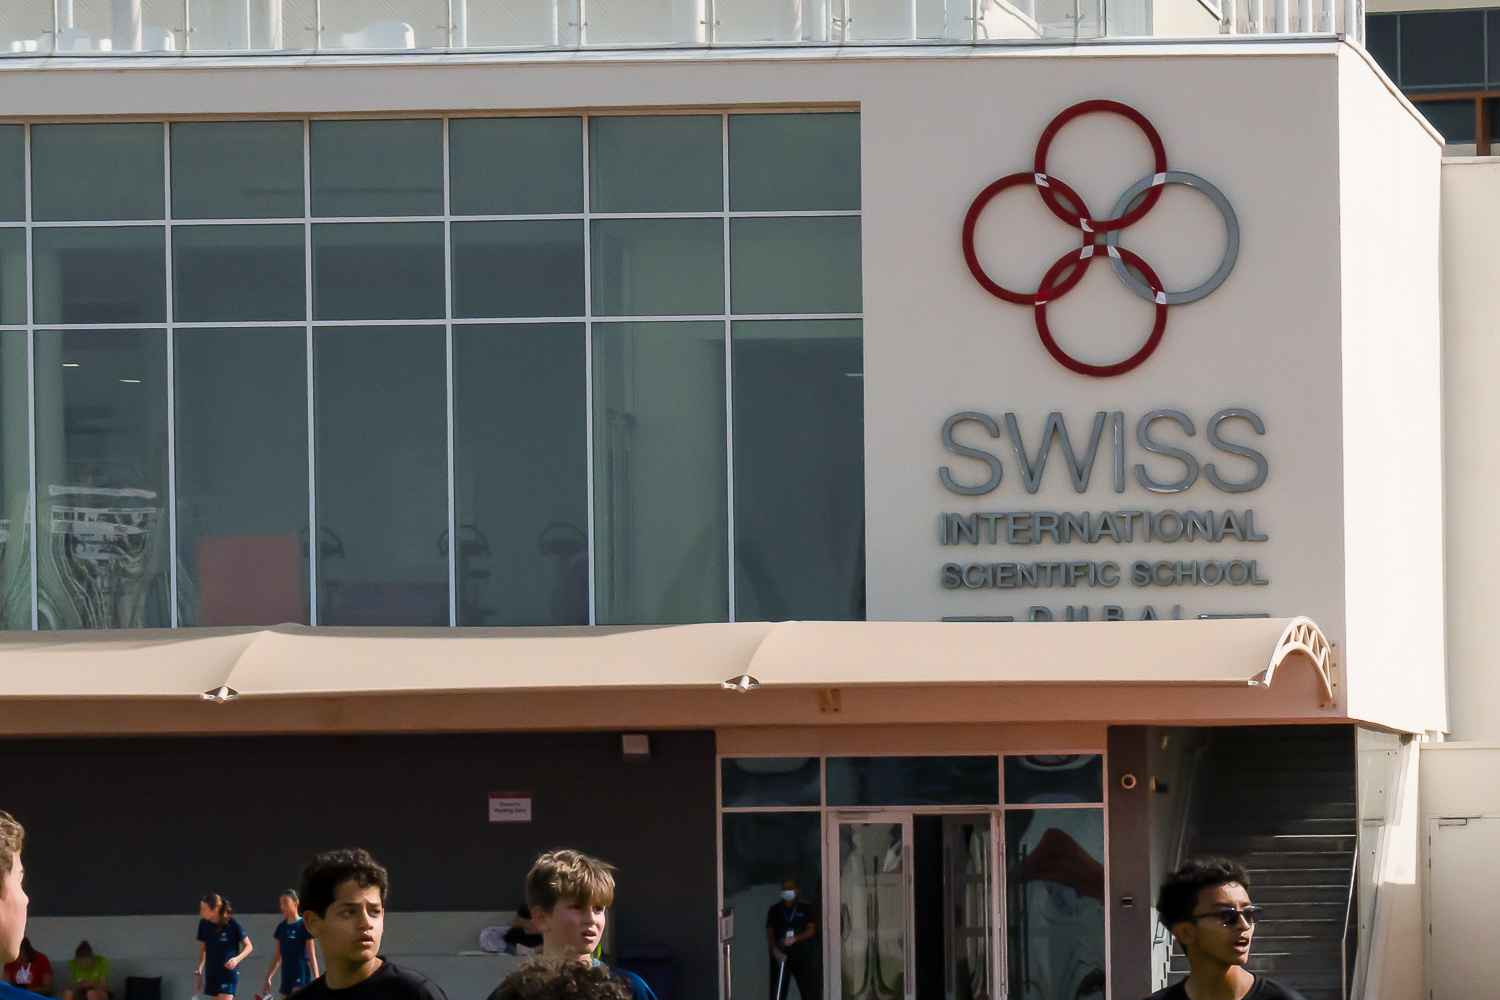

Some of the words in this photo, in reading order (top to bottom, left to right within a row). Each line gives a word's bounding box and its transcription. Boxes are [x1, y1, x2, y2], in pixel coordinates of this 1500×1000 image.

[938, 408, 1269, 496] SWISS
[939, 509, 1269, 545] INTERNATIONAL
[940, 561, 1121, 589] SCIENTIFIC
[1131, 559, 1269, 587] SCHOOL
